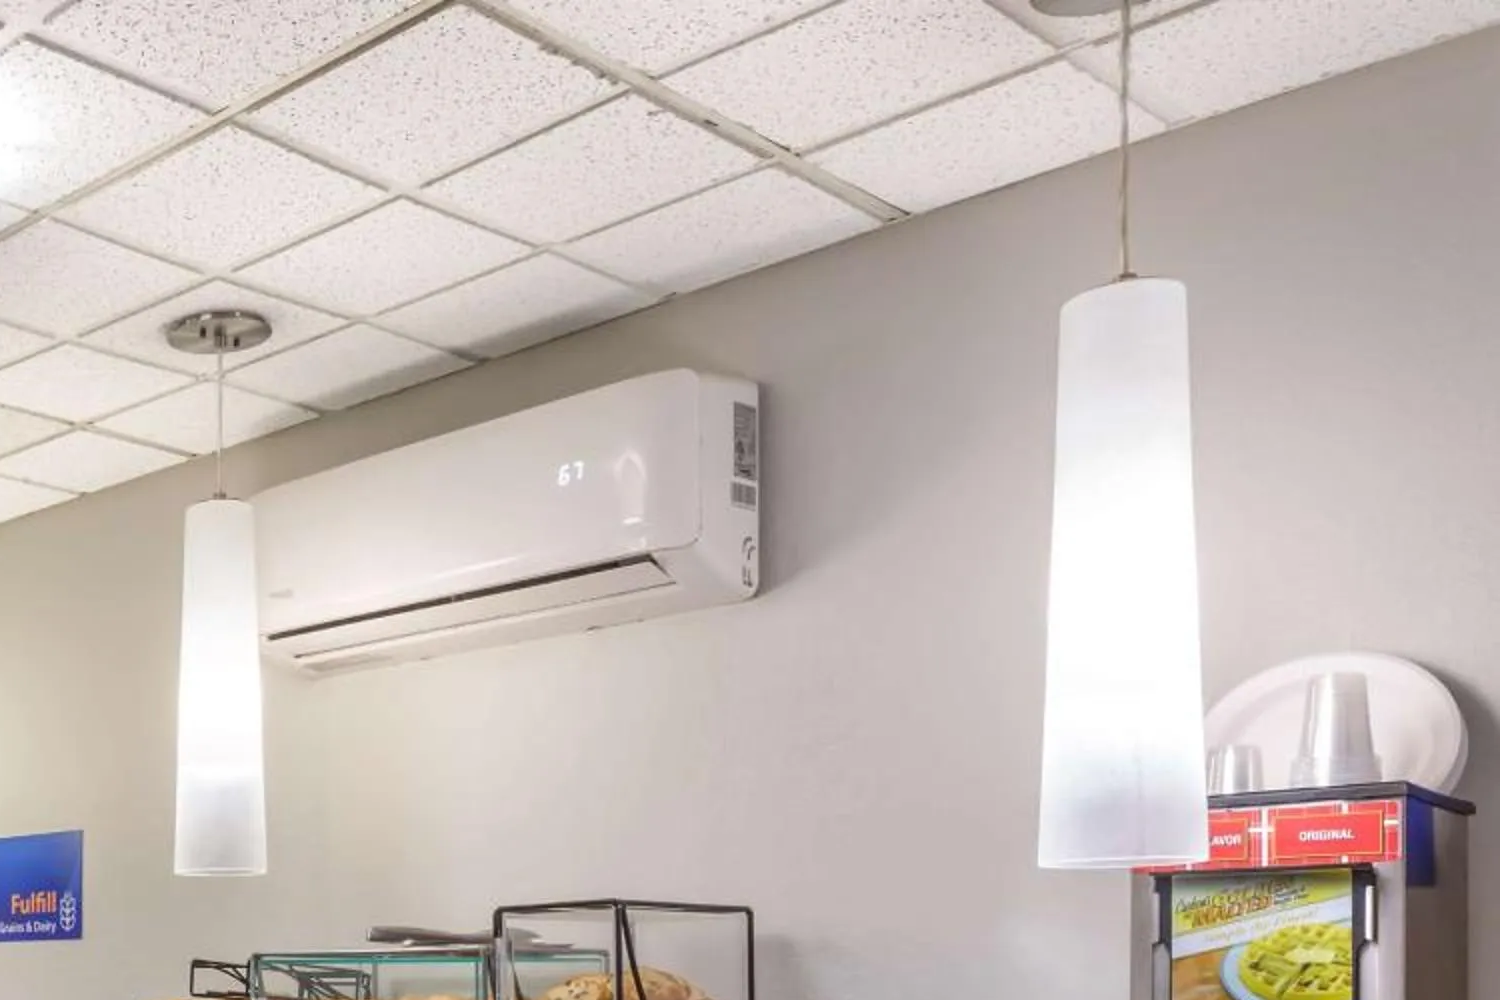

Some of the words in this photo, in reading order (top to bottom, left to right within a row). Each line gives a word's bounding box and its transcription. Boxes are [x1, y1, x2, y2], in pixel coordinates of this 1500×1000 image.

[559, 460, 584, 486] 67
[1210, 833, 1242, 847] AVOR
[1299, 828, 1355, 843] ORIGINAL
[11, 890, 57, 915] Fulfill
